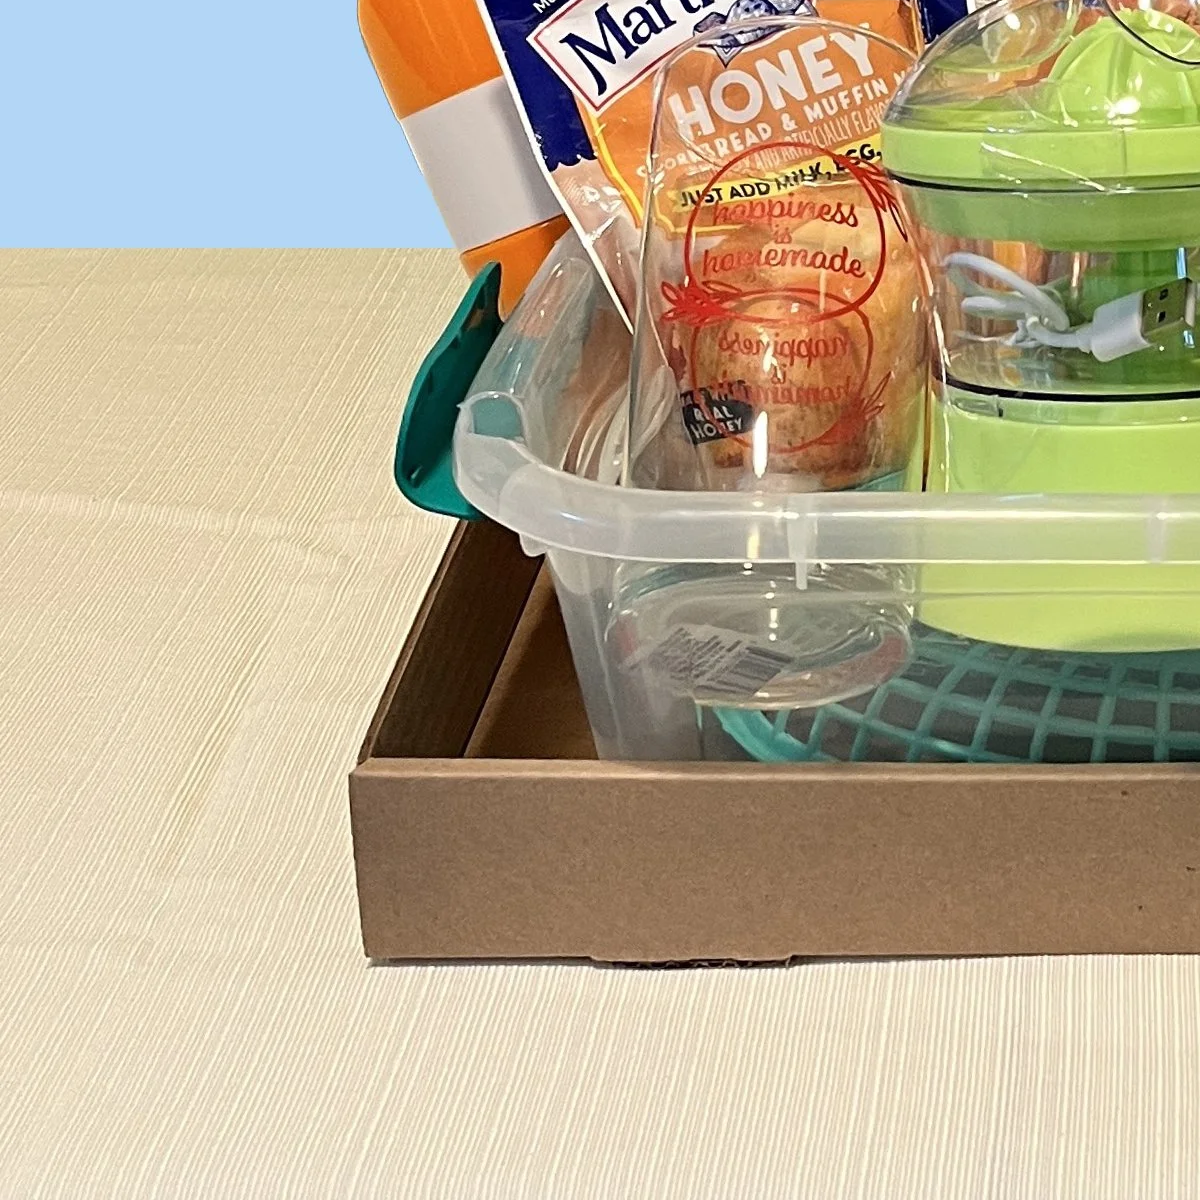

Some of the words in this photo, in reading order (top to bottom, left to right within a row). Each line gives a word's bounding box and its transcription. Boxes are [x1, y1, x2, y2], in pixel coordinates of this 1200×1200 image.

[667, 23, 875, 141] HONEY
[781, 113, 798, 131] &
[803, 78, 889, 123] MUFFIN
[681, 187, 723, 207] JUST
[730, 182, 770, 199] ADD
[712, 192, 859, 228] happiness
[772, 223, 793, 244] is
[702, 246, 866, 278] homemade
[693, 405, 734, 422] RAL
